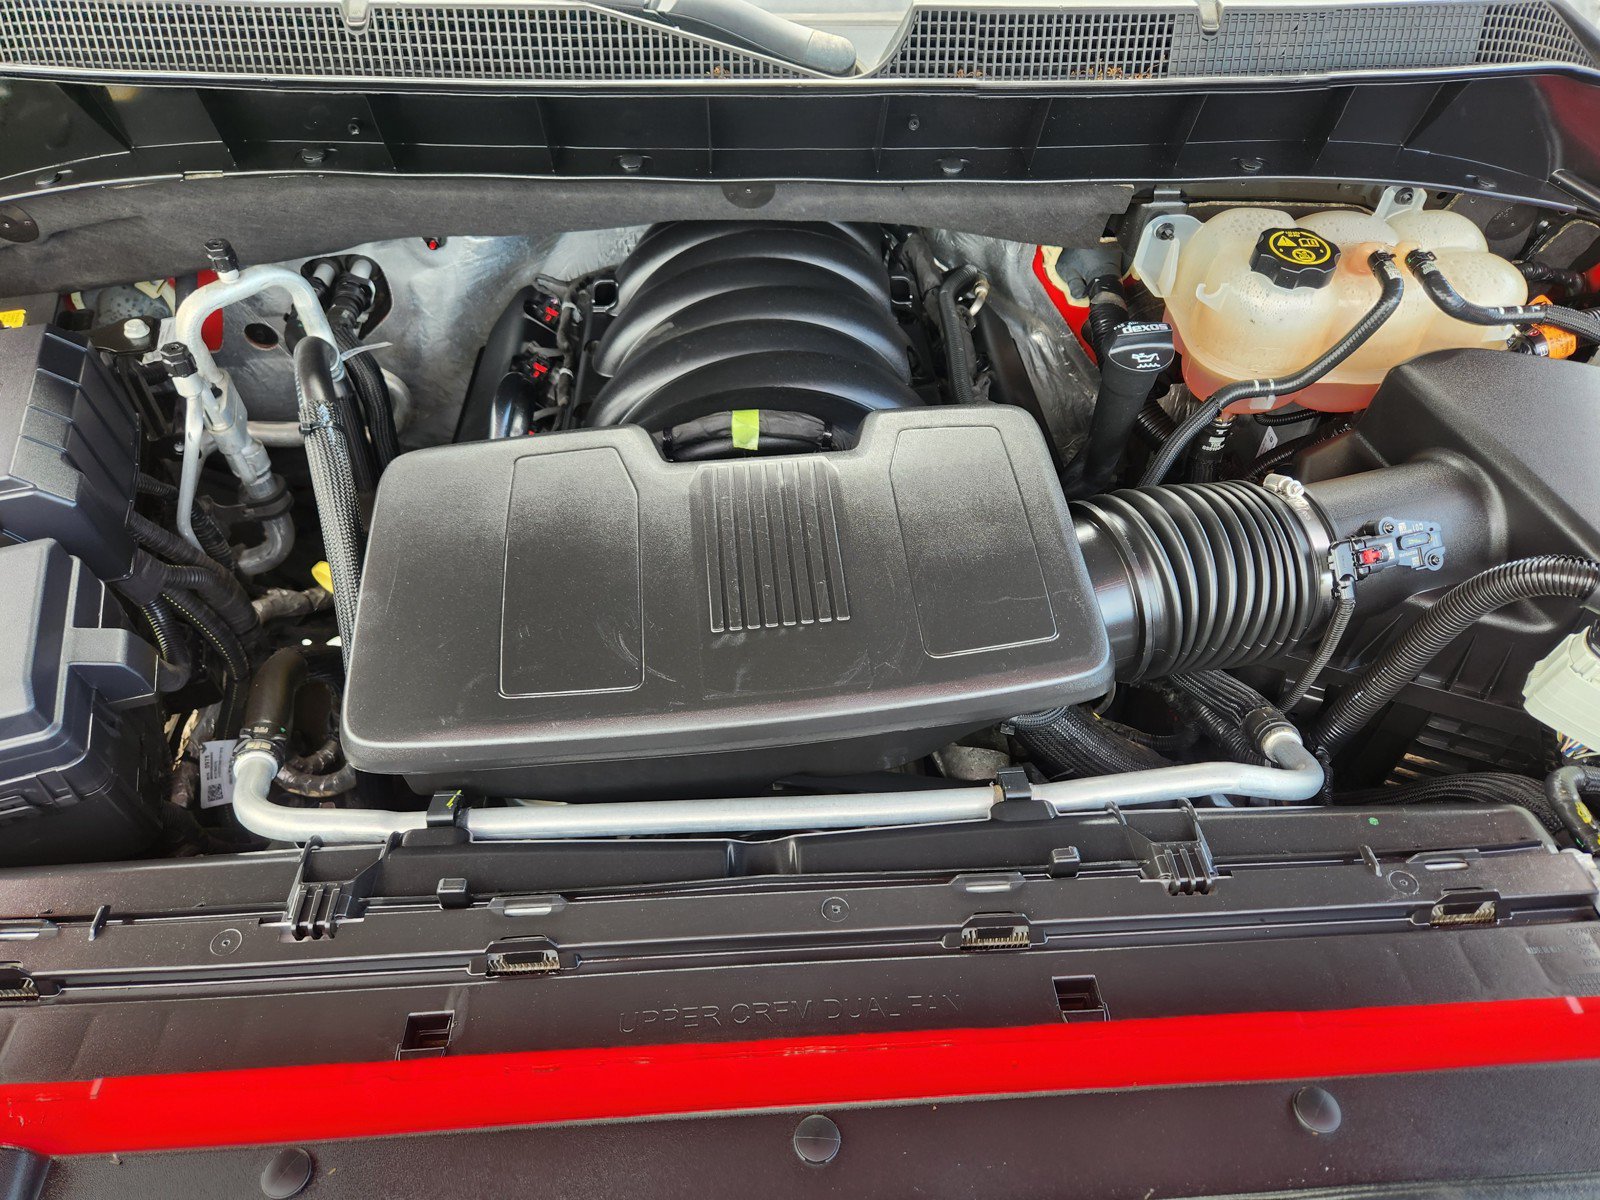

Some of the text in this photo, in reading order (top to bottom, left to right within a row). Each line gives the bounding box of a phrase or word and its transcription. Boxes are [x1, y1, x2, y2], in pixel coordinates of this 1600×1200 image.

[1122, 323, 1168, 334] dexos
[619, 1005, 722, 1033] UPPER
[823, 997, 901, 1018] DUAL
[906, 993, 960, 1014] FAN
